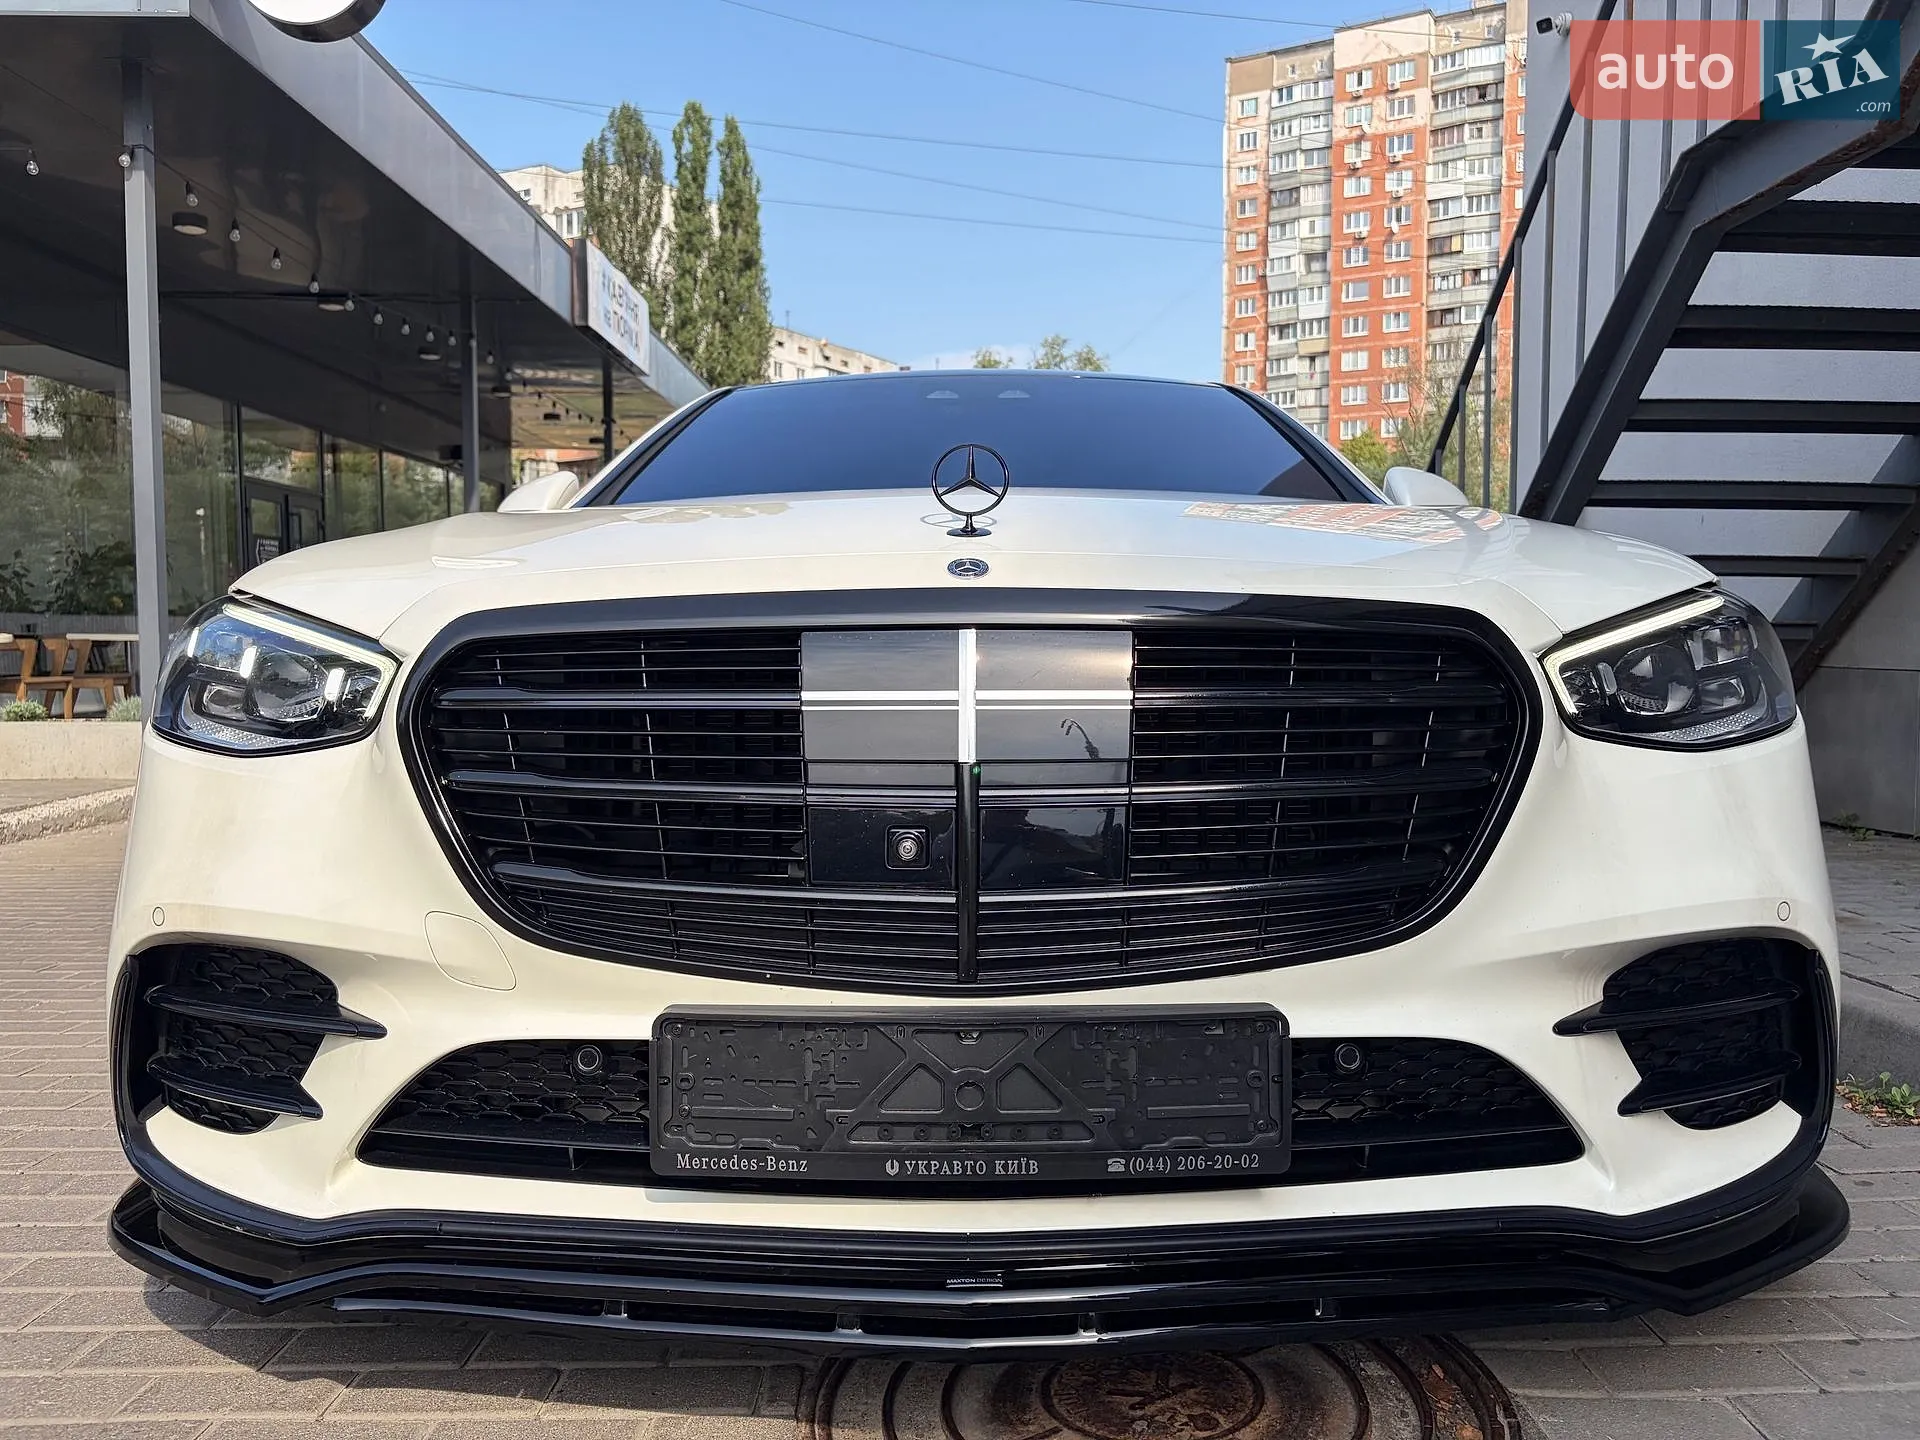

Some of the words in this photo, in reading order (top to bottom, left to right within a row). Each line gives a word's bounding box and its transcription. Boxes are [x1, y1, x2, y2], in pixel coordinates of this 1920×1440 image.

[676, 1153, 808, 1172] Mercedes-Benz
[904, 1160, 987, 1176] УКРАВТО
[994, 1157, 1039, 1175] КИЇВ
[1129, 1155, 1171, 1172] (044)
[1177, 1153, 1260, 1171] 206-20-02
